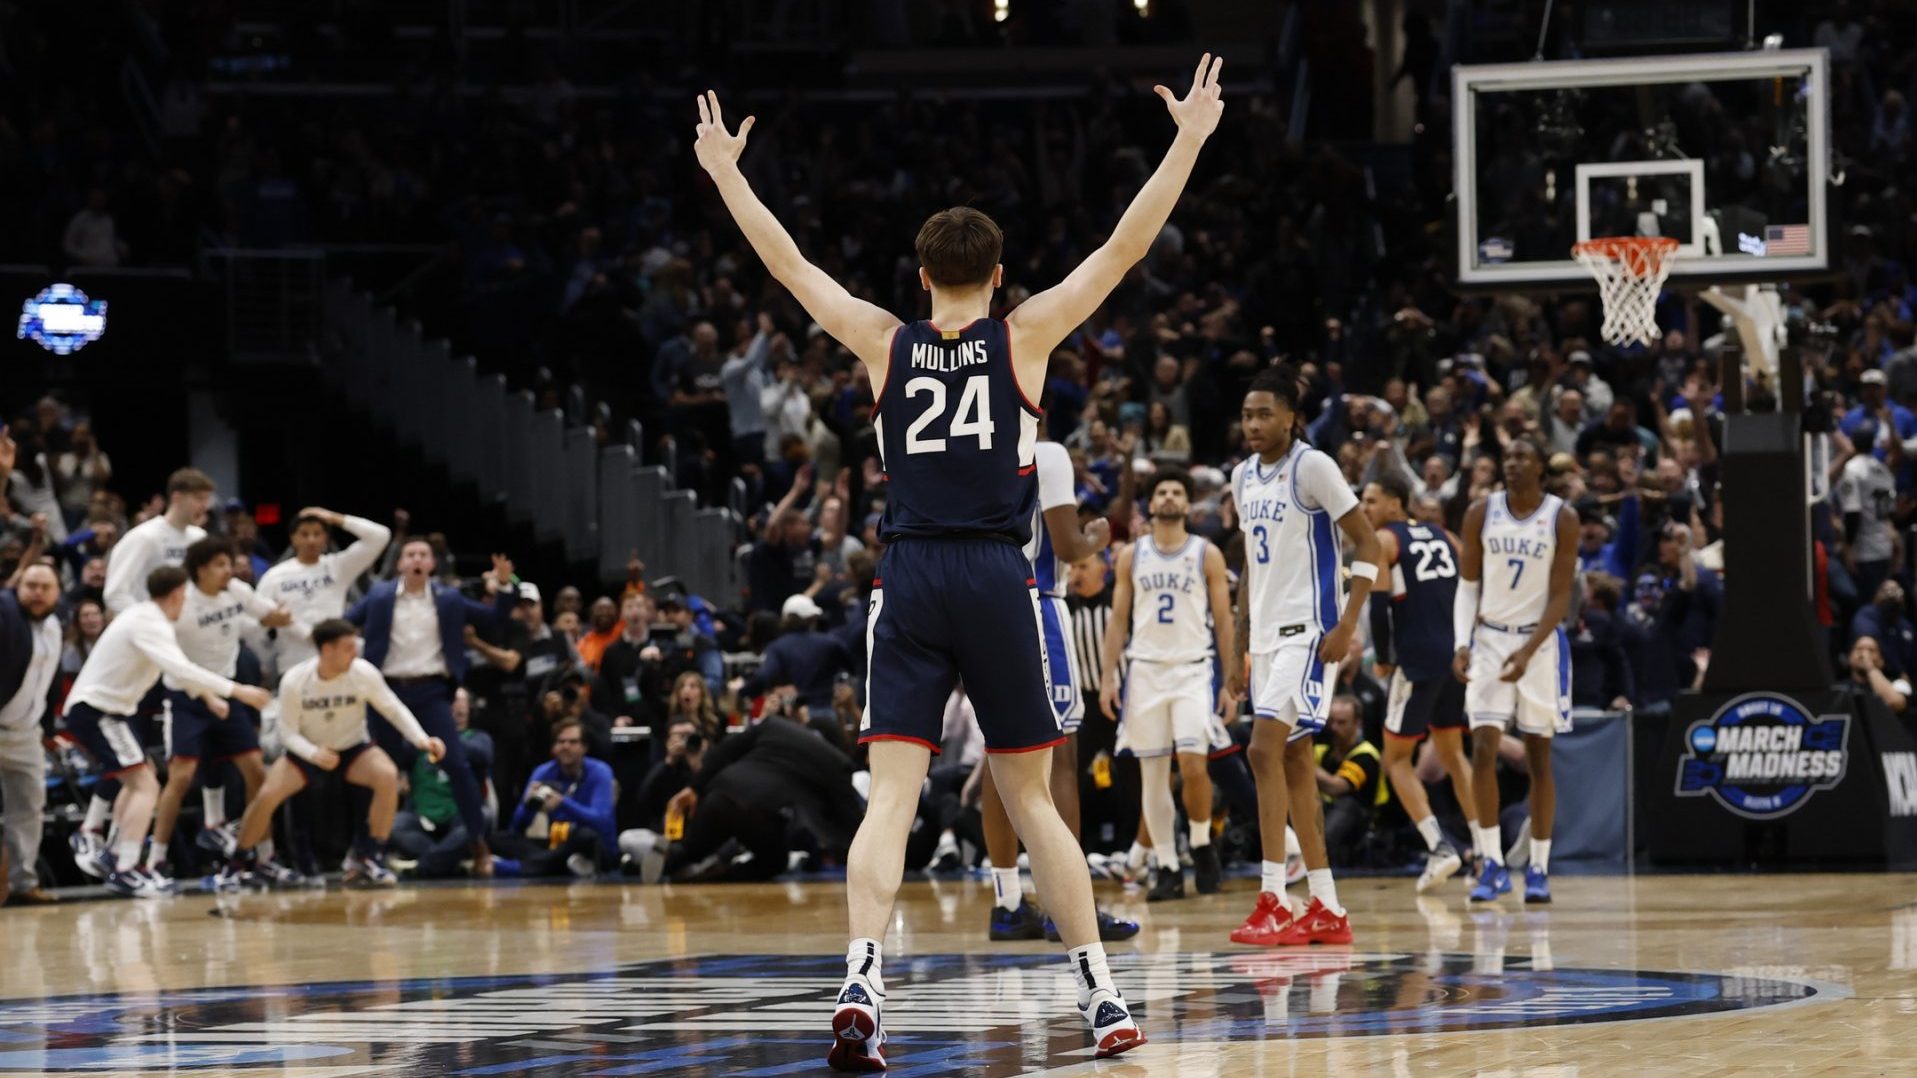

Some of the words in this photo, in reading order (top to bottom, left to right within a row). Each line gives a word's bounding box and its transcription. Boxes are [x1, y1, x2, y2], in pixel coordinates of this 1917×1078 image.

[911, 340, 989, 372] MULLINS
[905, 375, 995, 455] 24
[1243, 500, 1287, 522] DUKE
[1252, 525, 1270, 564] 3
[1489, 537, 1548, 559] DUKE
[1408, 540, 1457, 582] 23
[1507, 559, 1525, 590] 7
[1139, 573, 1197, 594] DUKE
[1157, 594, 1175, 624] 2
[1715, 725, 1803, 753] MARCH
[1726, 751, 1842, 779] MADNESS
